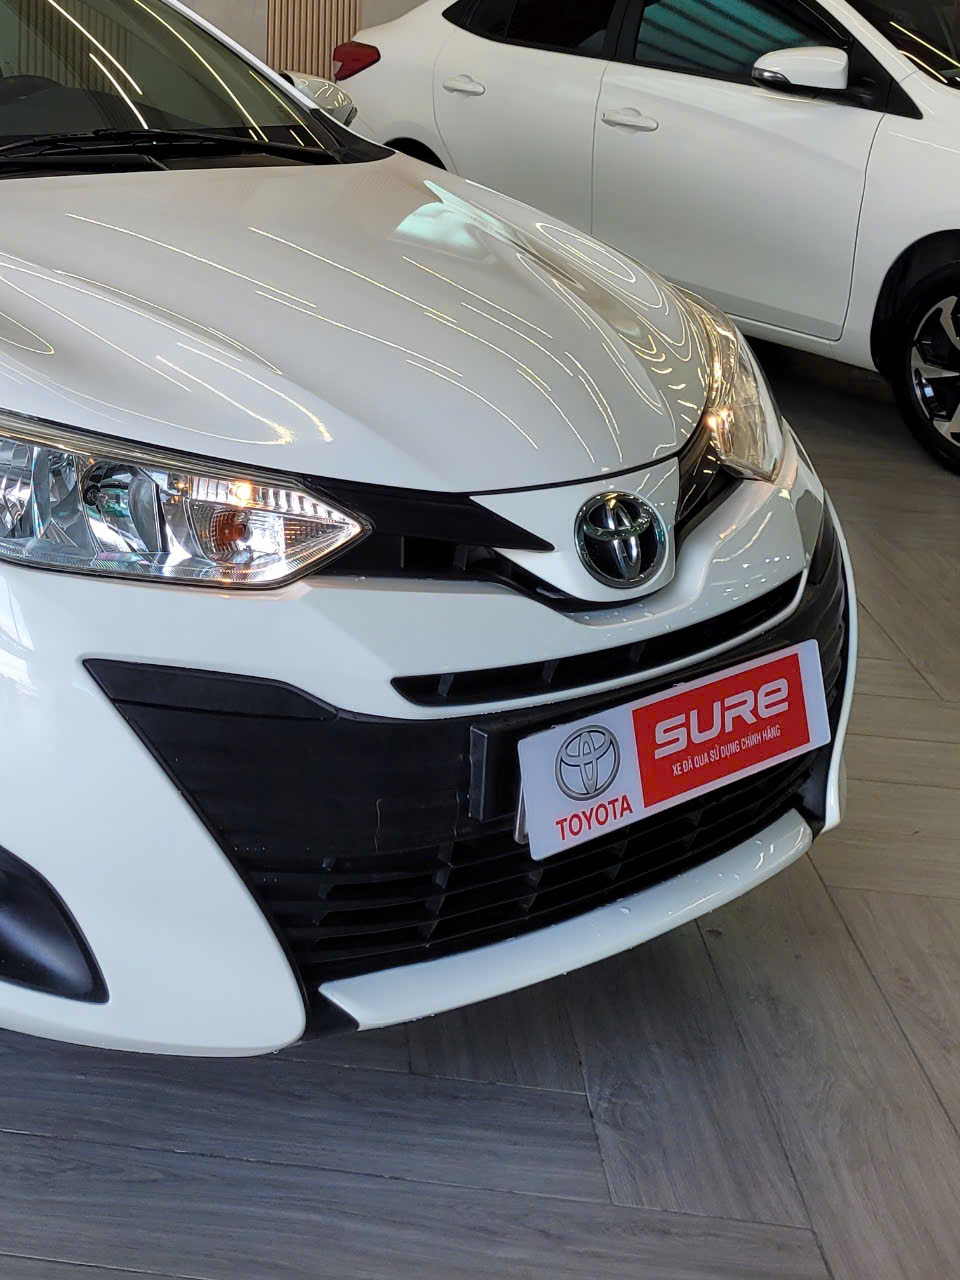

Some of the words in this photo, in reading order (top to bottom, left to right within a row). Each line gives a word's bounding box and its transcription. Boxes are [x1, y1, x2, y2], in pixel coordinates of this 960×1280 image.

[672, 762, 683, 776] XE
[694, 752, 709, 768] QUA
[555, 794, 633, 841] TOYOTA
